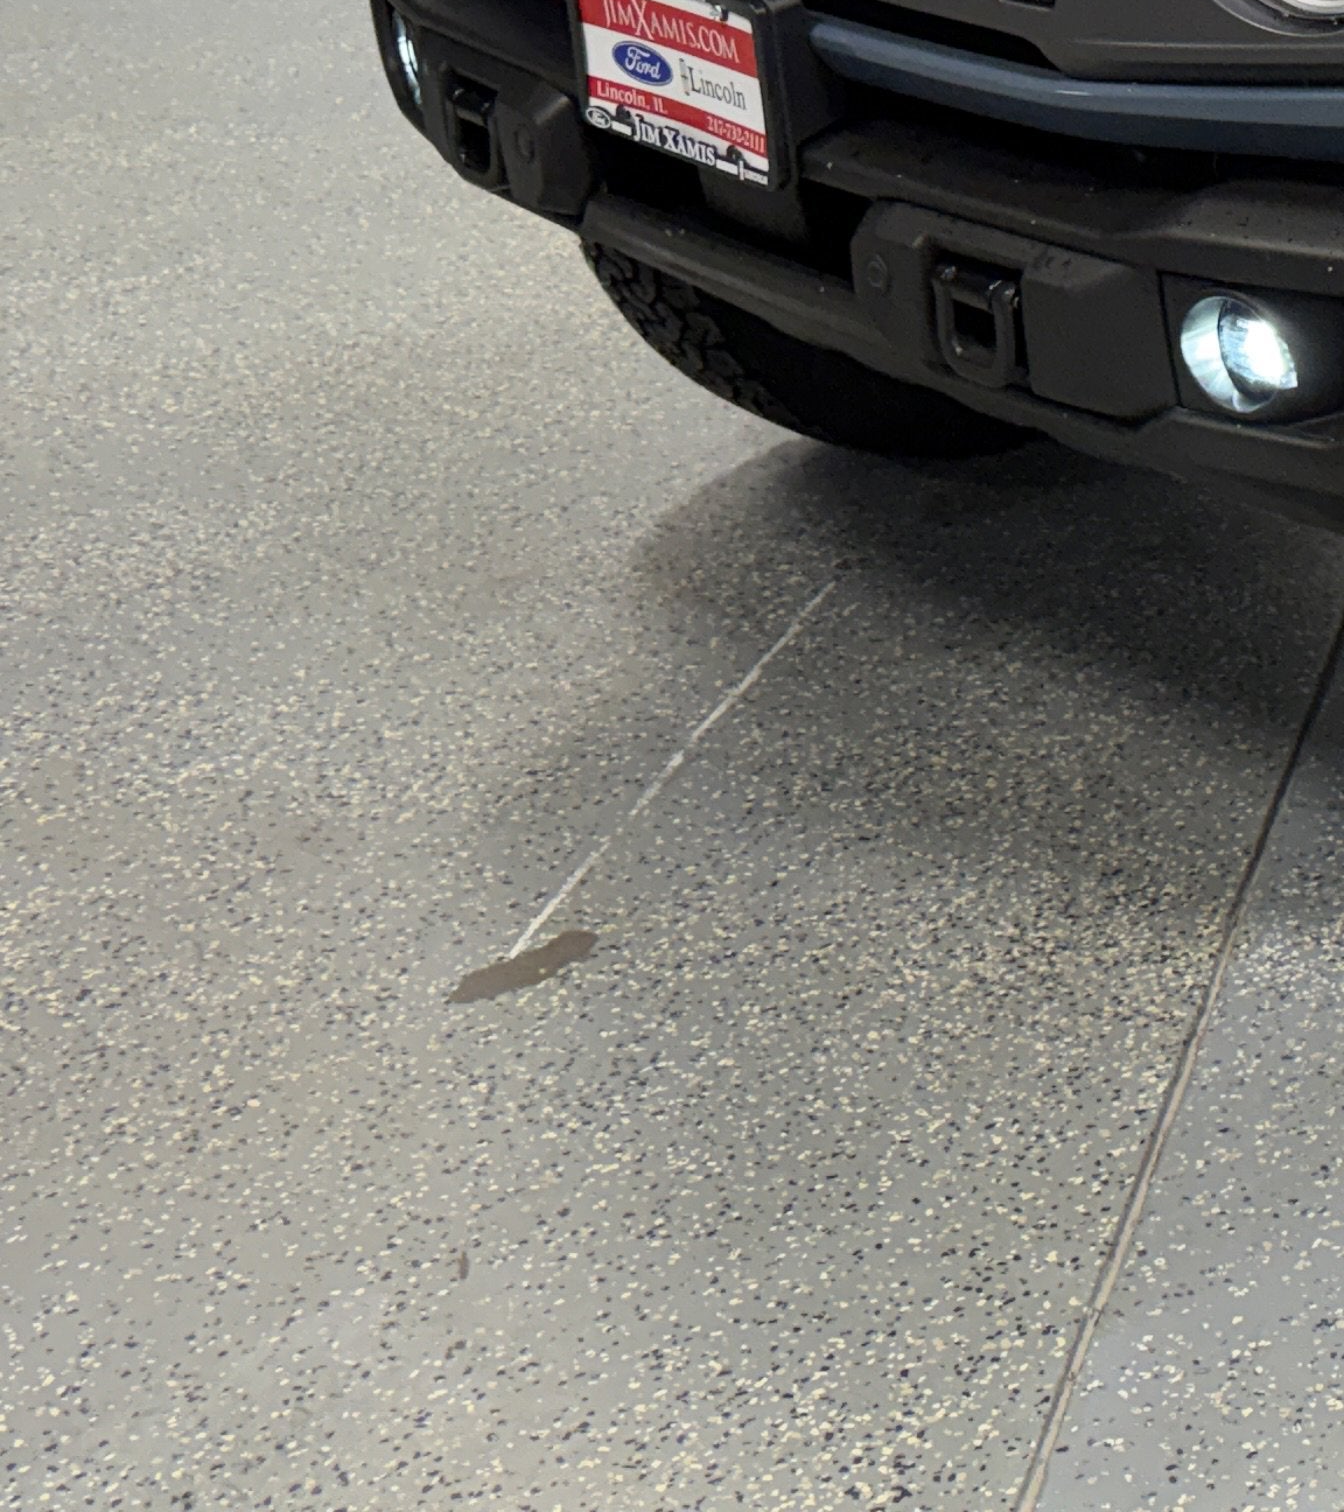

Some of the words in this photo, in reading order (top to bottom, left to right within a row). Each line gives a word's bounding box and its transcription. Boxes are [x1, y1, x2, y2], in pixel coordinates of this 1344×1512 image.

[624, 46, 662, 80] Ford
[652, 96, 668, 115] IL
[687, 66, 747, 111] Lincoln
[633, 115, 661, 143] JIM
[662, 128, 717, 167] XAMIS
